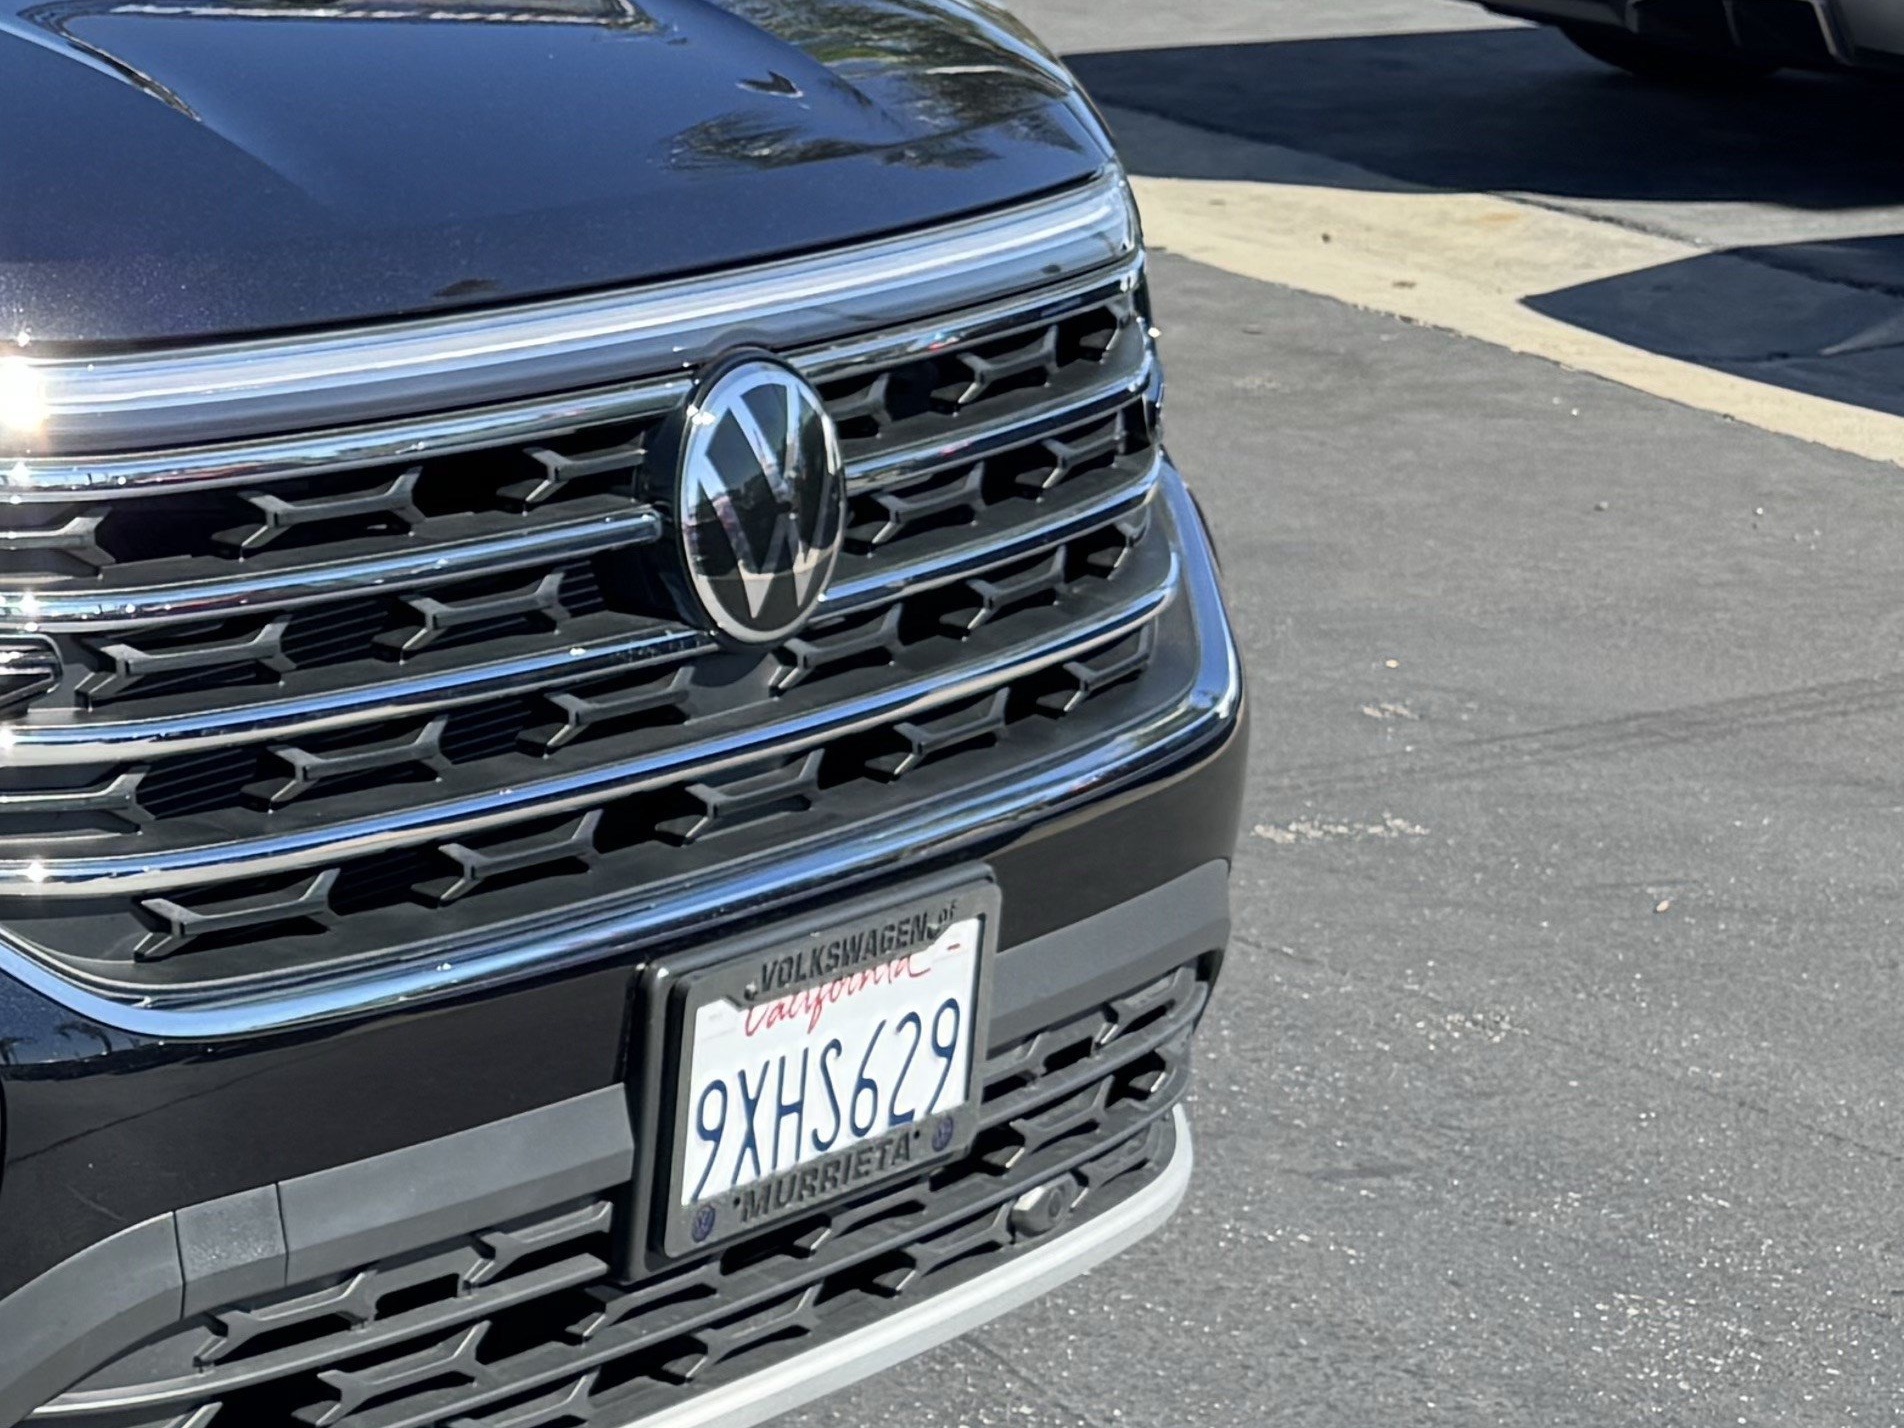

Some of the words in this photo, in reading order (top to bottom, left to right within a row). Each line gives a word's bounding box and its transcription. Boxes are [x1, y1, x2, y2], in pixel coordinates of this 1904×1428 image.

[757, 913, 929, 993] VOLKSWAGEN
[693, 997, 961, 1204] 9XHS629
[740, 1131, 913, 1223] MURRIETA
